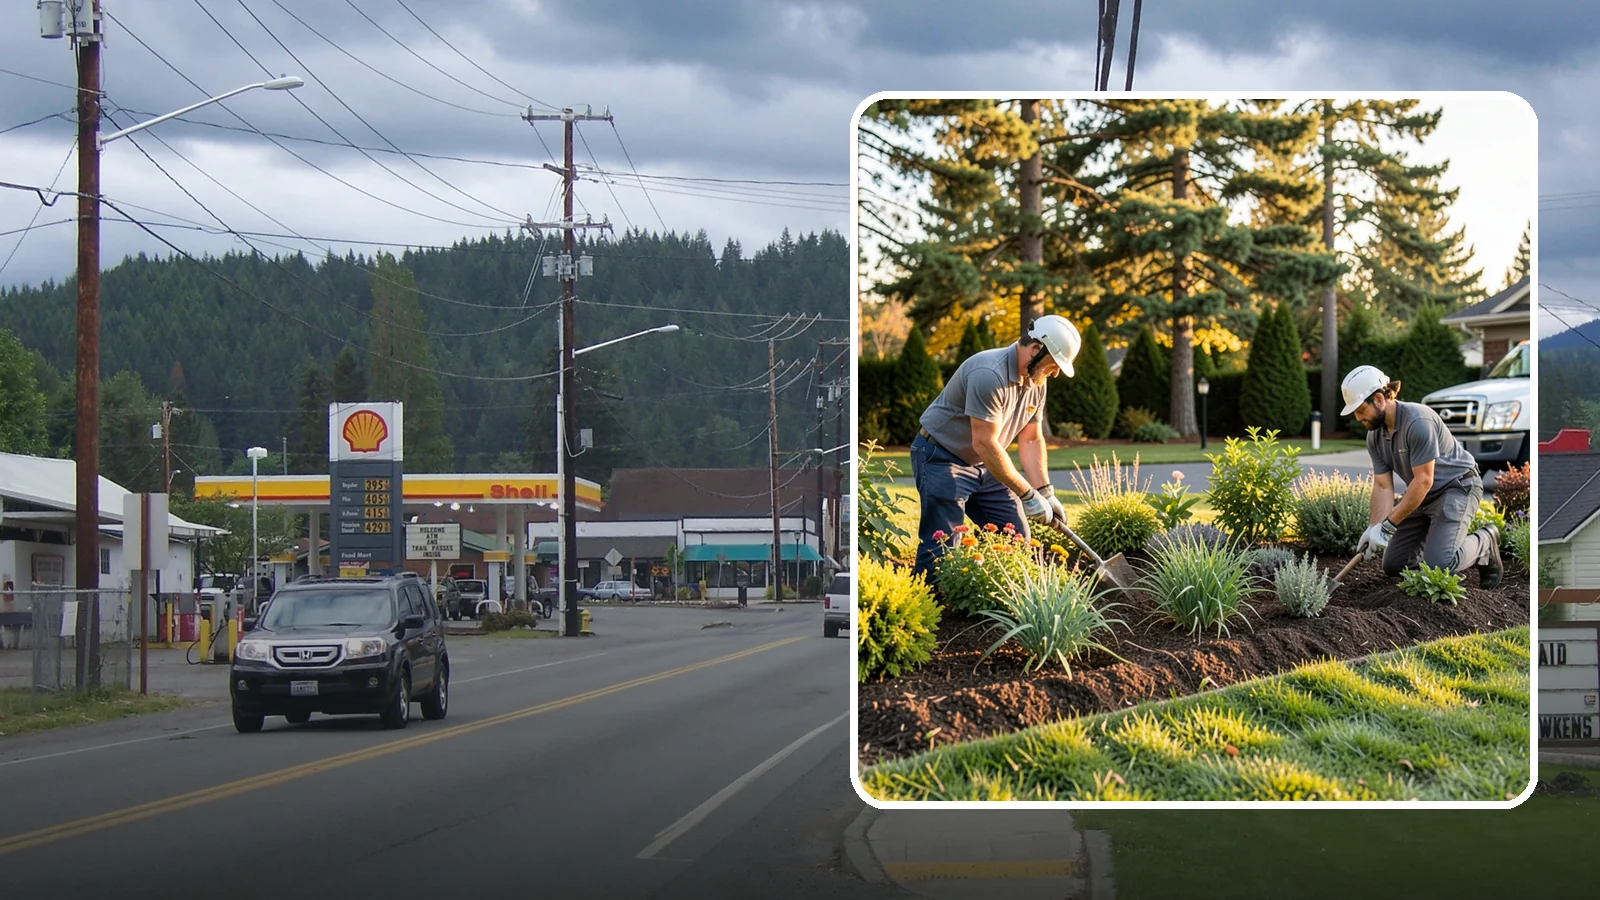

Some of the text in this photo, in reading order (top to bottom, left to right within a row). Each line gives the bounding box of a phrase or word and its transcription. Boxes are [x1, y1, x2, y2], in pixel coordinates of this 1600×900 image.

[365, 480, 383, 490] 395
[490, 484, 547, 499] Shell
[365, 494, 383, 504] 405
[365, 508, 383, 518] 415
[365, 522, 383, 532] 429
